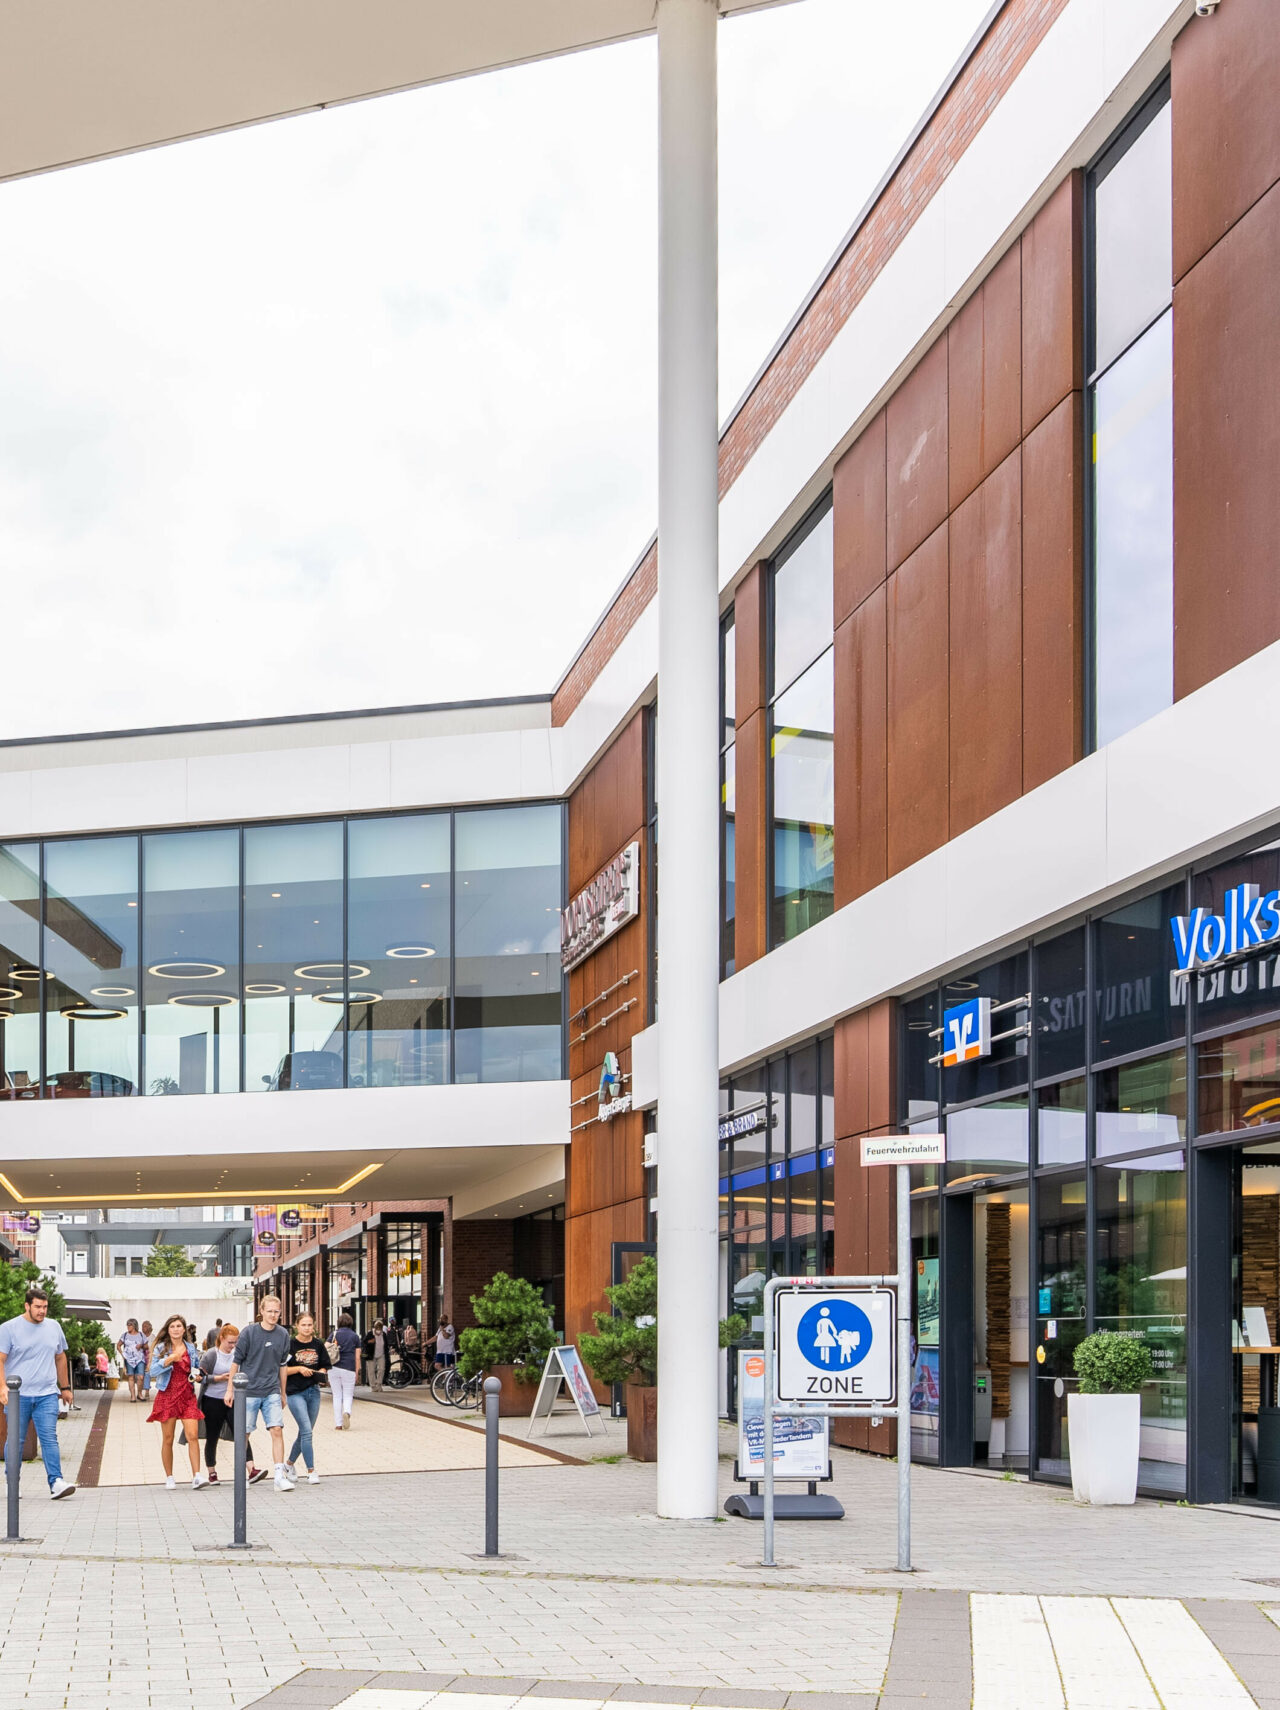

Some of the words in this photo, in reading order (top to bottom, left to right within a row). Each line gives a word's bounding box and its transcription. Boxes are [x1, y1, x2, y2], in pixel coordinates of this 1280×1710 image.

[1170, 883, 1280, 971] Volks
[734, 1113, 756, 1135] BRAND
[866, 1144, 939, 1156] Feuerwehrzufahrt
[1165, 1350, 1174, 1358] Uhr
[1165, 1361, 1174, 1369] Uhr
[806, 1376, 863, 1394] ZONE
